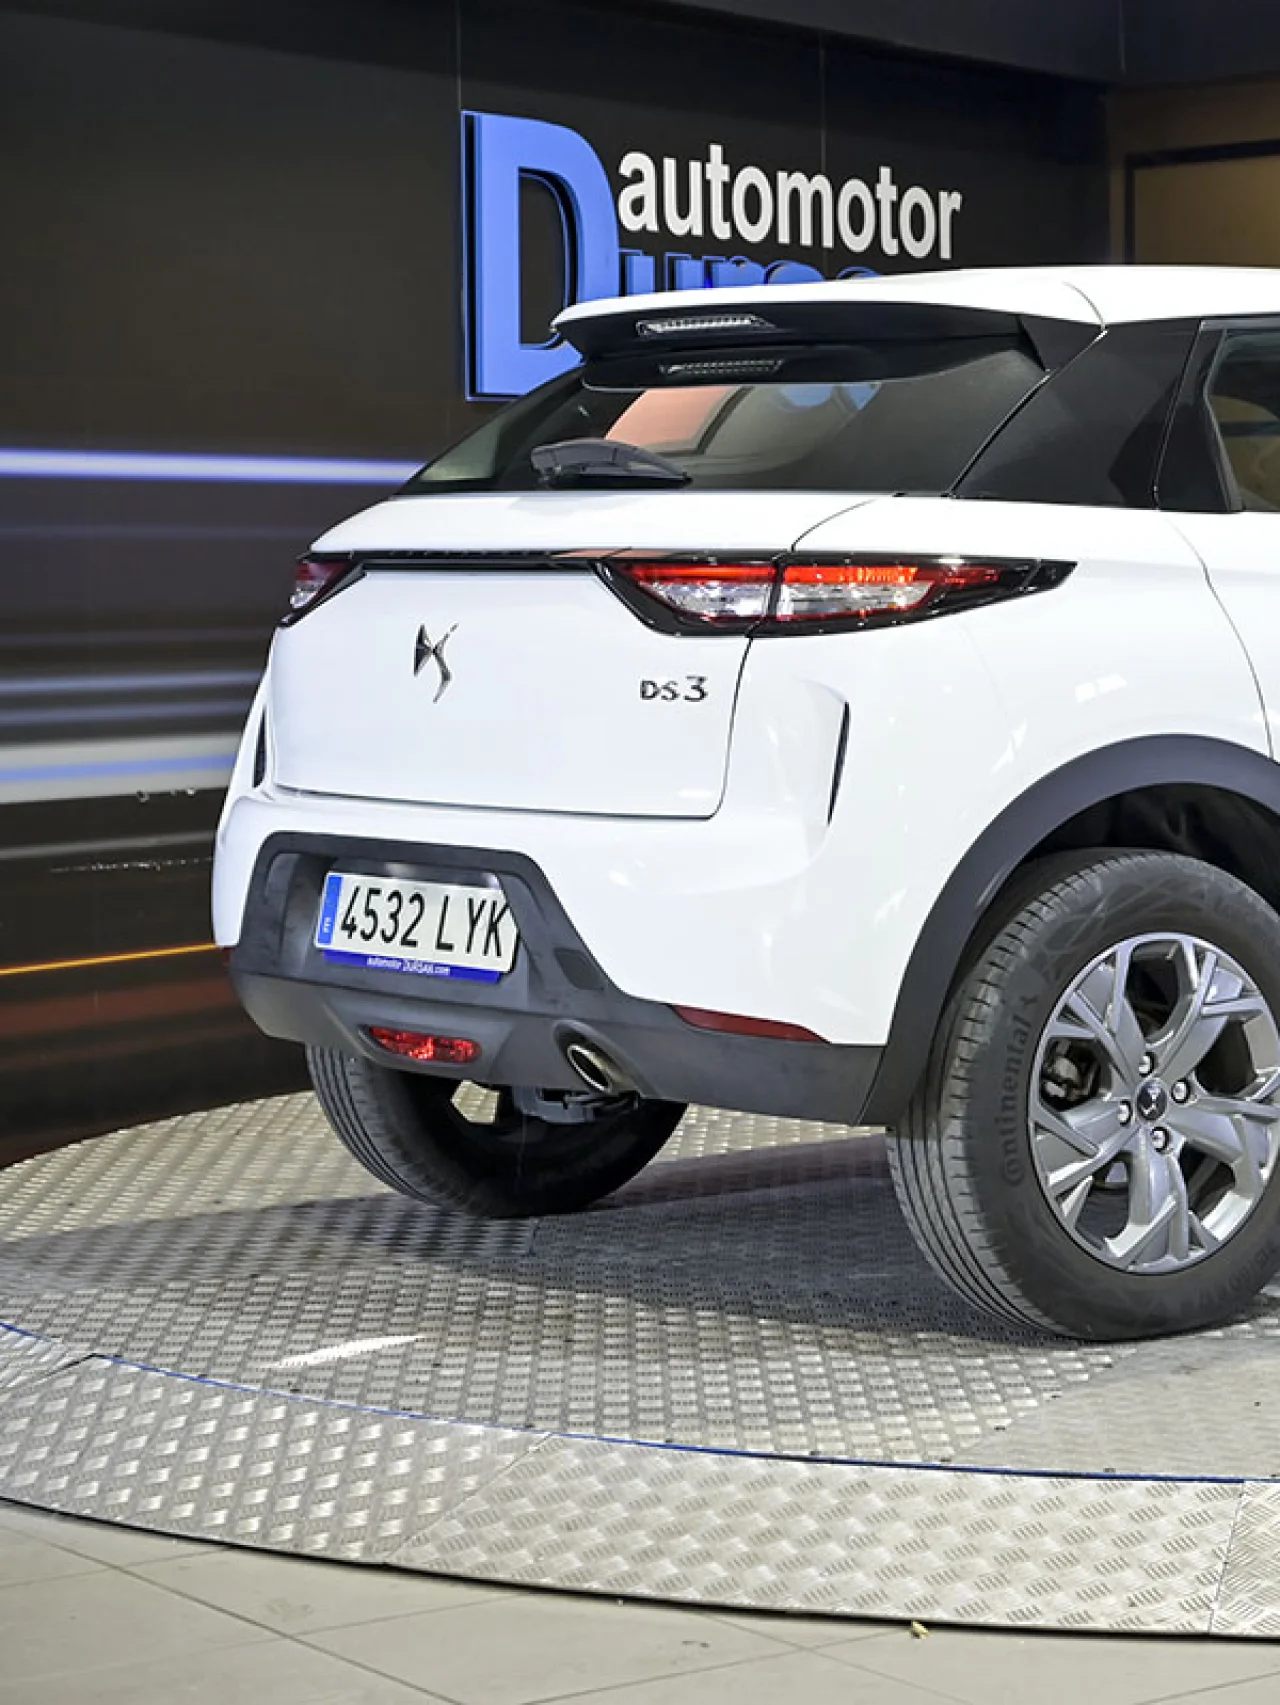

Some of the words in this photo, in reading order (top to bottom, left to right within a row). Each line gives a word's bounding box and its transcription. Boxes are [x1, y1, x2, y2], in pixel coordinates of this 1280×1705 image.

[618, 143, 962, 259] automotor
[341, 885, 425, 947] 4532
[435, 894, 510, 957] LYK
[997, 1015, 1032, 1187] Continental
